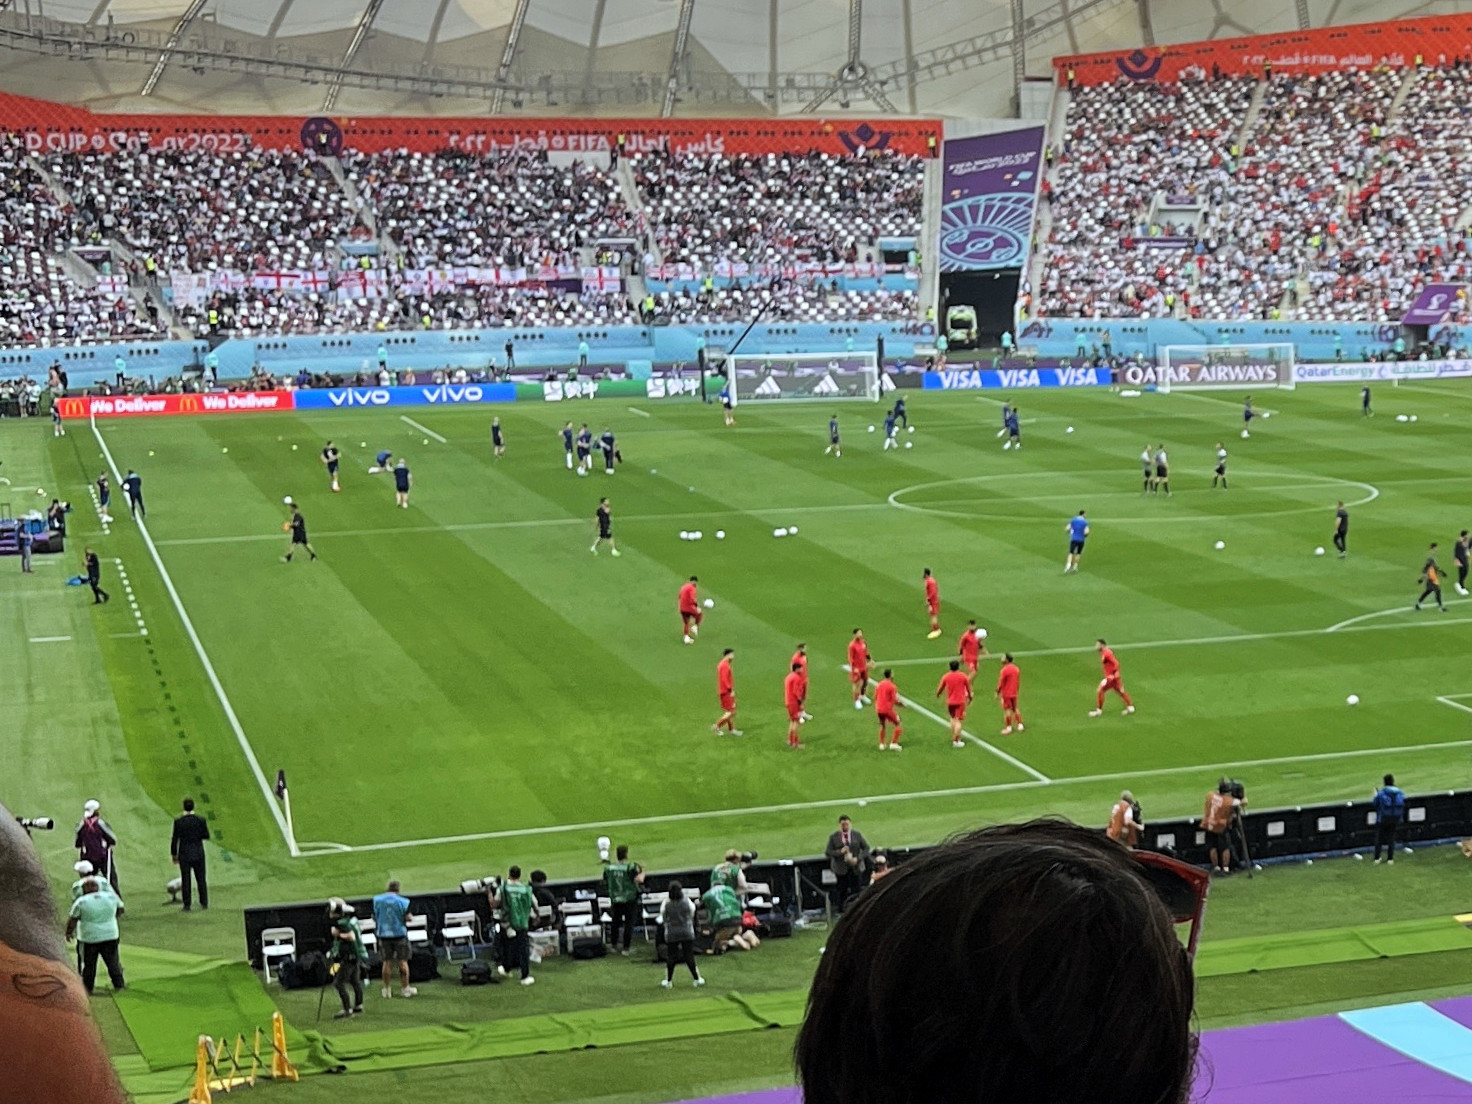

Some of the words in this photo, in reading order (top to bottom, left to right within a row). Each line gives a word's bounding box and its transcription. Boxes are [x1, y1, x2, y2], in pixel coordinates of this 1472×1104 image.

[46, 132, 88, 150] CUP
[568, 134, 610, 150] FIFA
[938, 370, 982, 389] VISA
[997, 369, 1041, 388] VISA
[1055, 367, 1098, 386] VISA
[1126, 365, 1191, 384] QATAR
[1195, 364, 1277, 382] AIRWAYS
[90, 399, 113, 414] We
[115, 397, 166, 413] Deliver
[202, 397, 226, 409] We
[227, 395, 278, 409] Deliver
[328, 387, 390, 406] vivo
[422, 385, 483, 403] vivo
